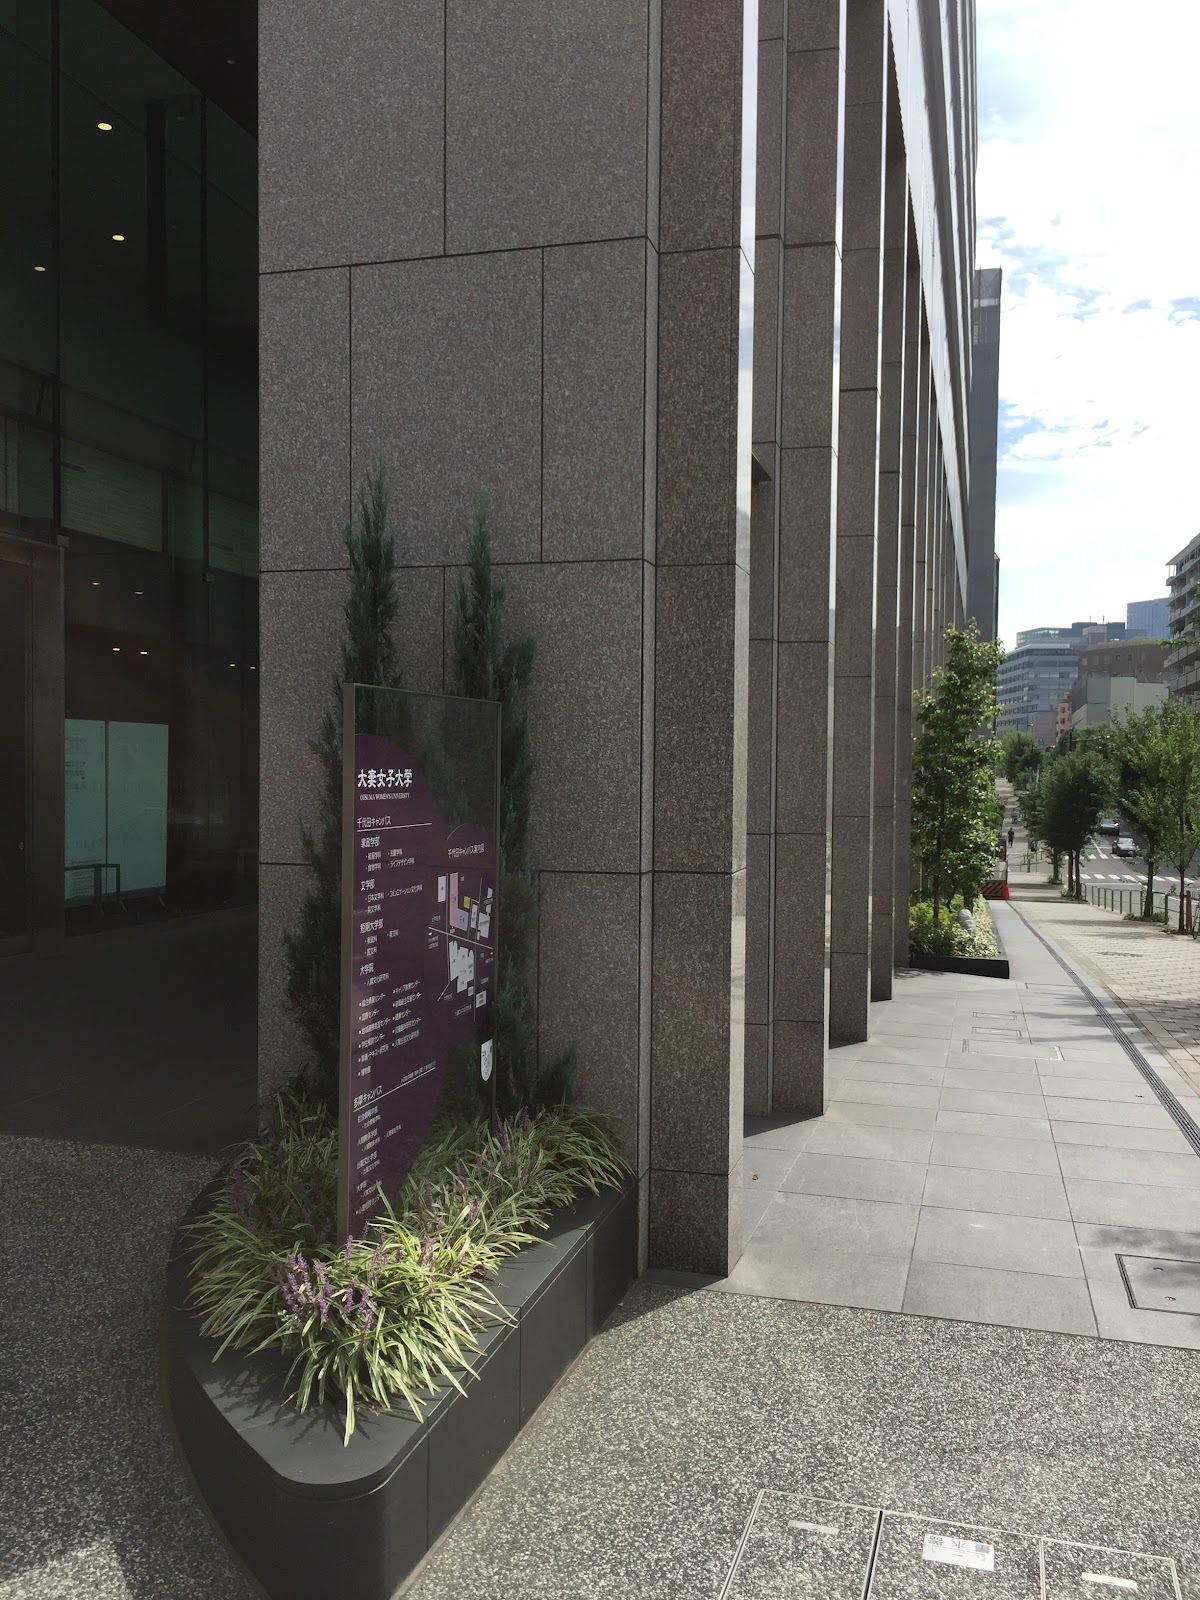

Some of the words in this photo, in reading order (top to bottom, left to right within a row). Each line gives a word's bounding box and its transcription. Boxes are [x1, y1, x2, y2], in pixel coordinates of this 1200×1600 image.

[358, 768, 412, 788] 大妻女子大学
[357, 816, 392, 828] 千代田キャンパス
[360, 879, 375, 891] 文学部
[360, 962, 375, 976] 大学院
[353, 1085, 383, 1109] 多摩キャンパス
